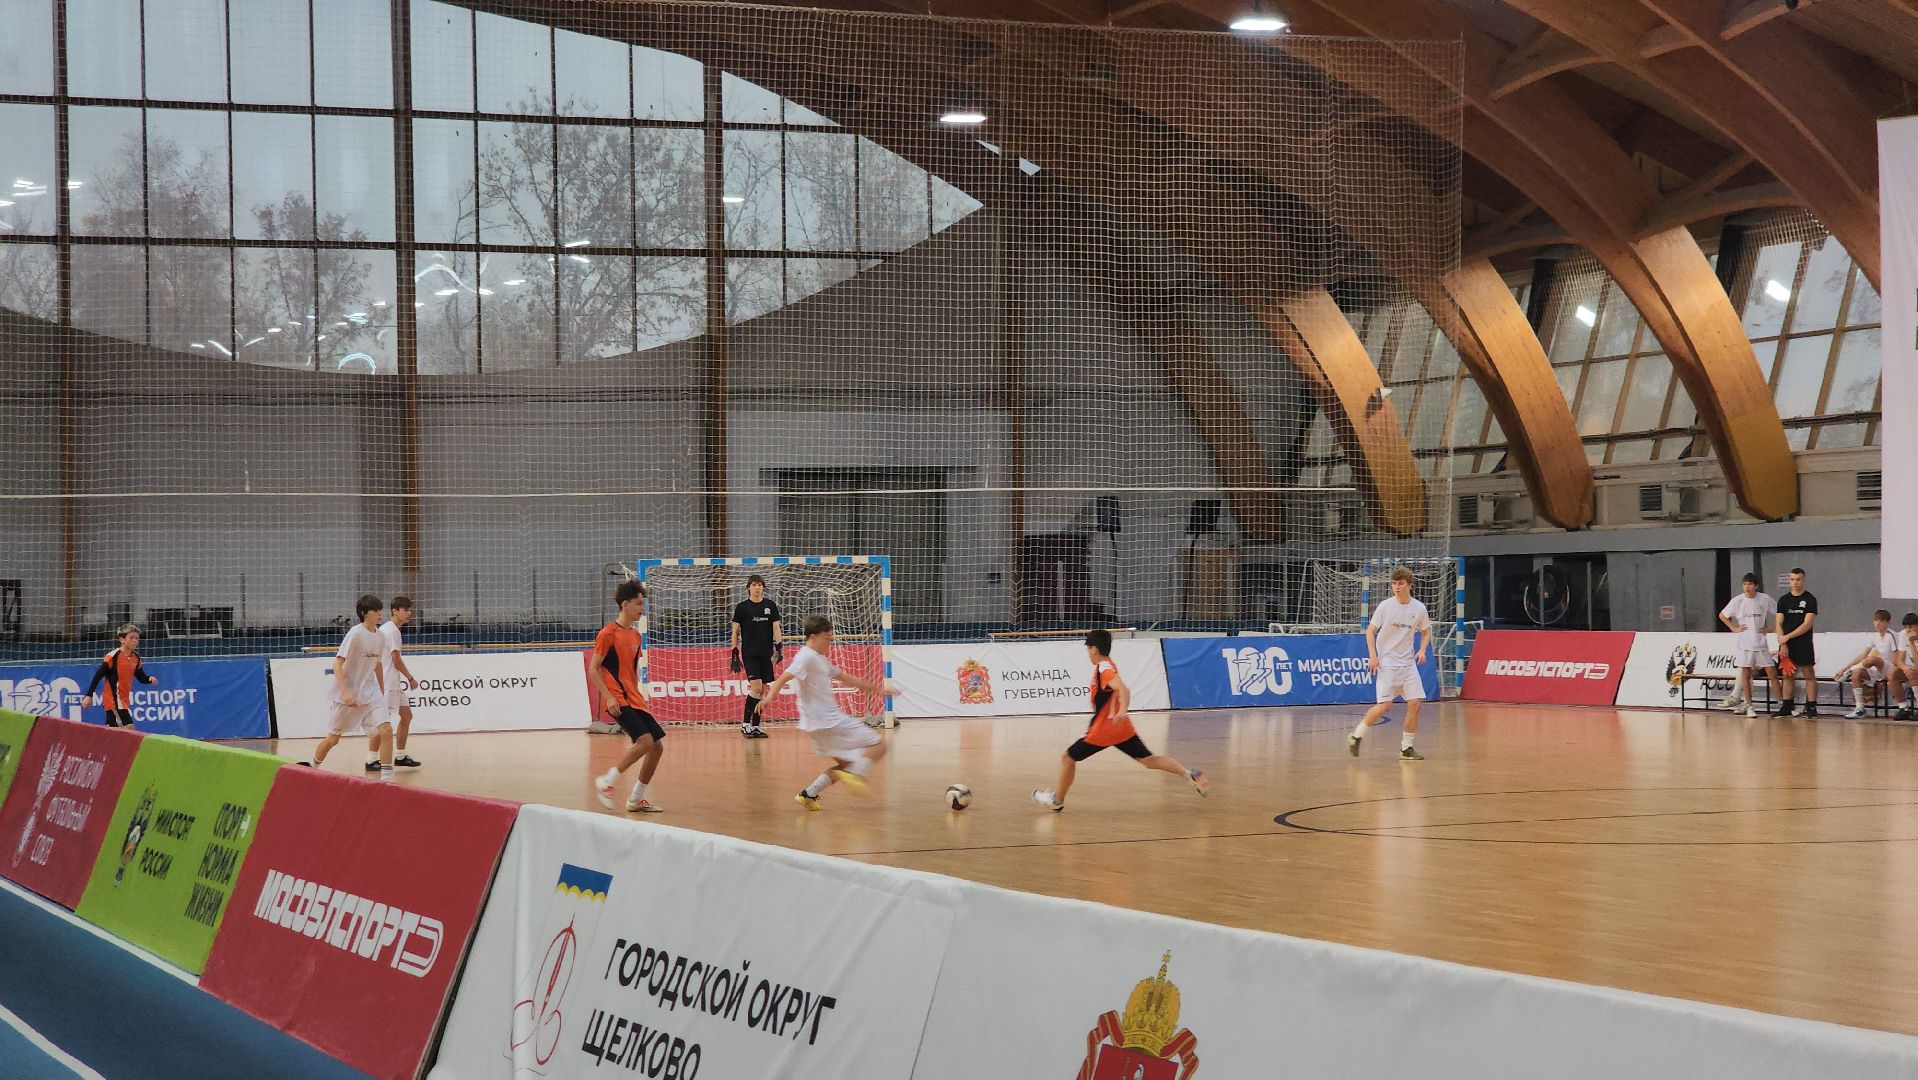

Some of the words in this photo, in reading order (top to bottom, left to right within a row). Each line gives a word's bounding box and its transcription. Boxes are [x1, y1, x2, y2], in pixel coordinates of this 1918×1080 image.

[1298, 657, 1370, 672] МИНСПОР
[1706, 654, 1738, 669] МИНС
[1001, 669, 1072, 681] КОМАНДА
[1311, 671, 1372, 686] РОССИИ
[489, 677, 538, 689] ОКРУГ
[92, 688, 198, 707] МСПОРТ
[1004, 686, 1091, 699] ГУБЕРНАТОР
[408, 695, 471, 708] ЕЛКОВО
[129, 705, 185, 722] ССИИ
[139, 847, 174, 880] РОССИИ
[198, 842, 239, 886] НОРМА
[604, 938, 751, 1021] ГОРОДСКОЙ
[747, 979, 837, 1046] ОКРУГ
[581, 1008, 702, 1080] ЩЕЛКОВО
